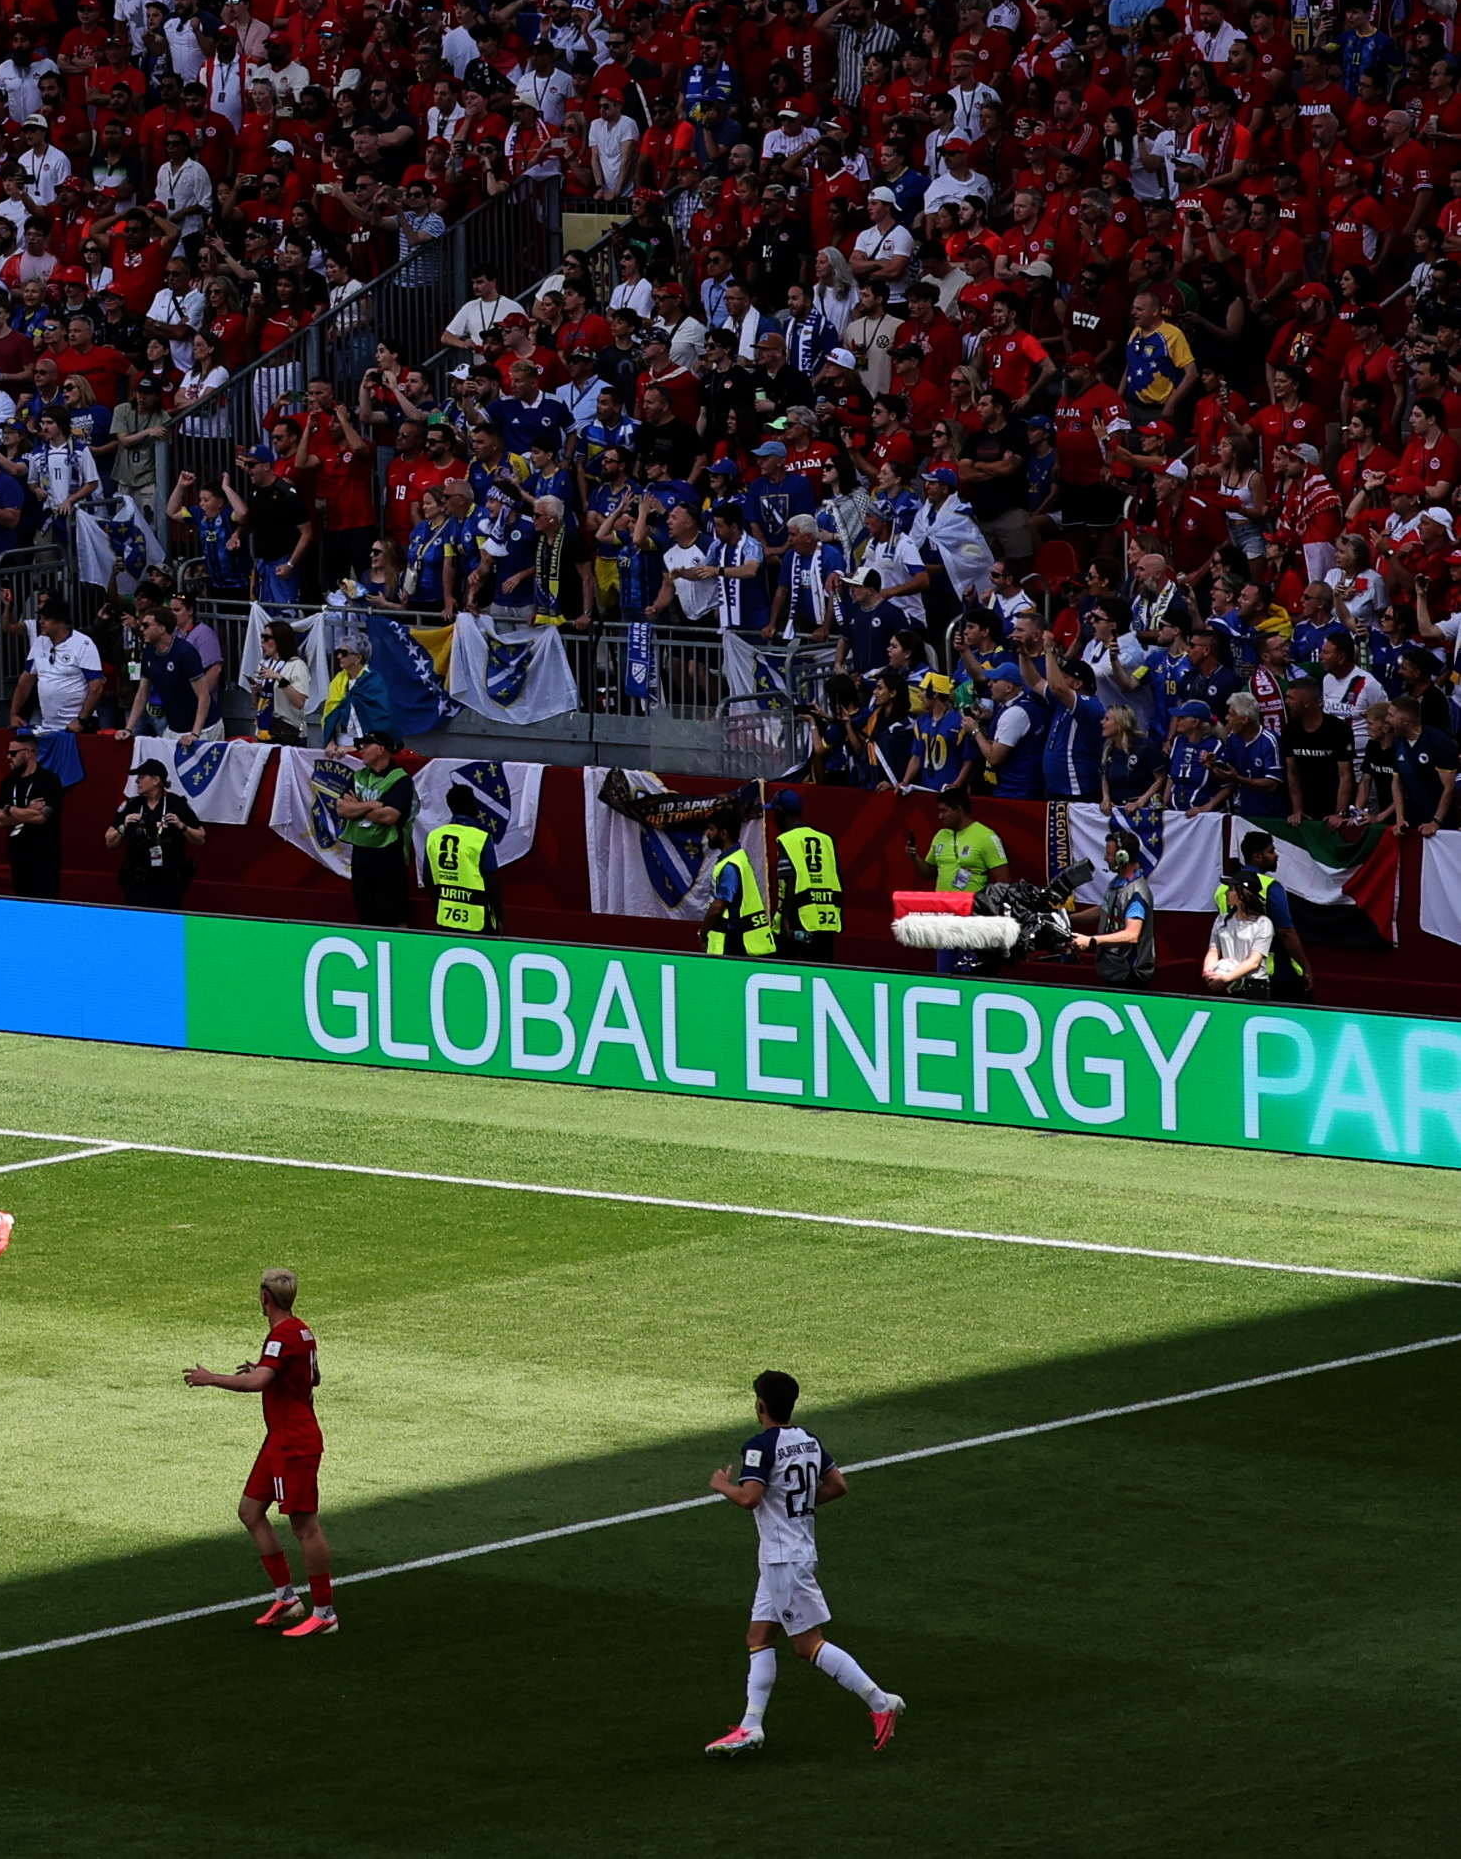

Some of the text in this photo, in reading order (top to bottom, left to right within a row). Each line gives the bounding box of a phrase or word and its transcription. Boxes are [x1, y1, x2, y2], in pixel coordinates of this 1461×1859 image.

[395, 484, 407, 501] 19
[443, 906, 469, 923] 763
[303, 936, 717, 1088] GLOBAL
[744, 972, 1212, 1132] ENERGY
[273, 1476, 285, 1501] 11
